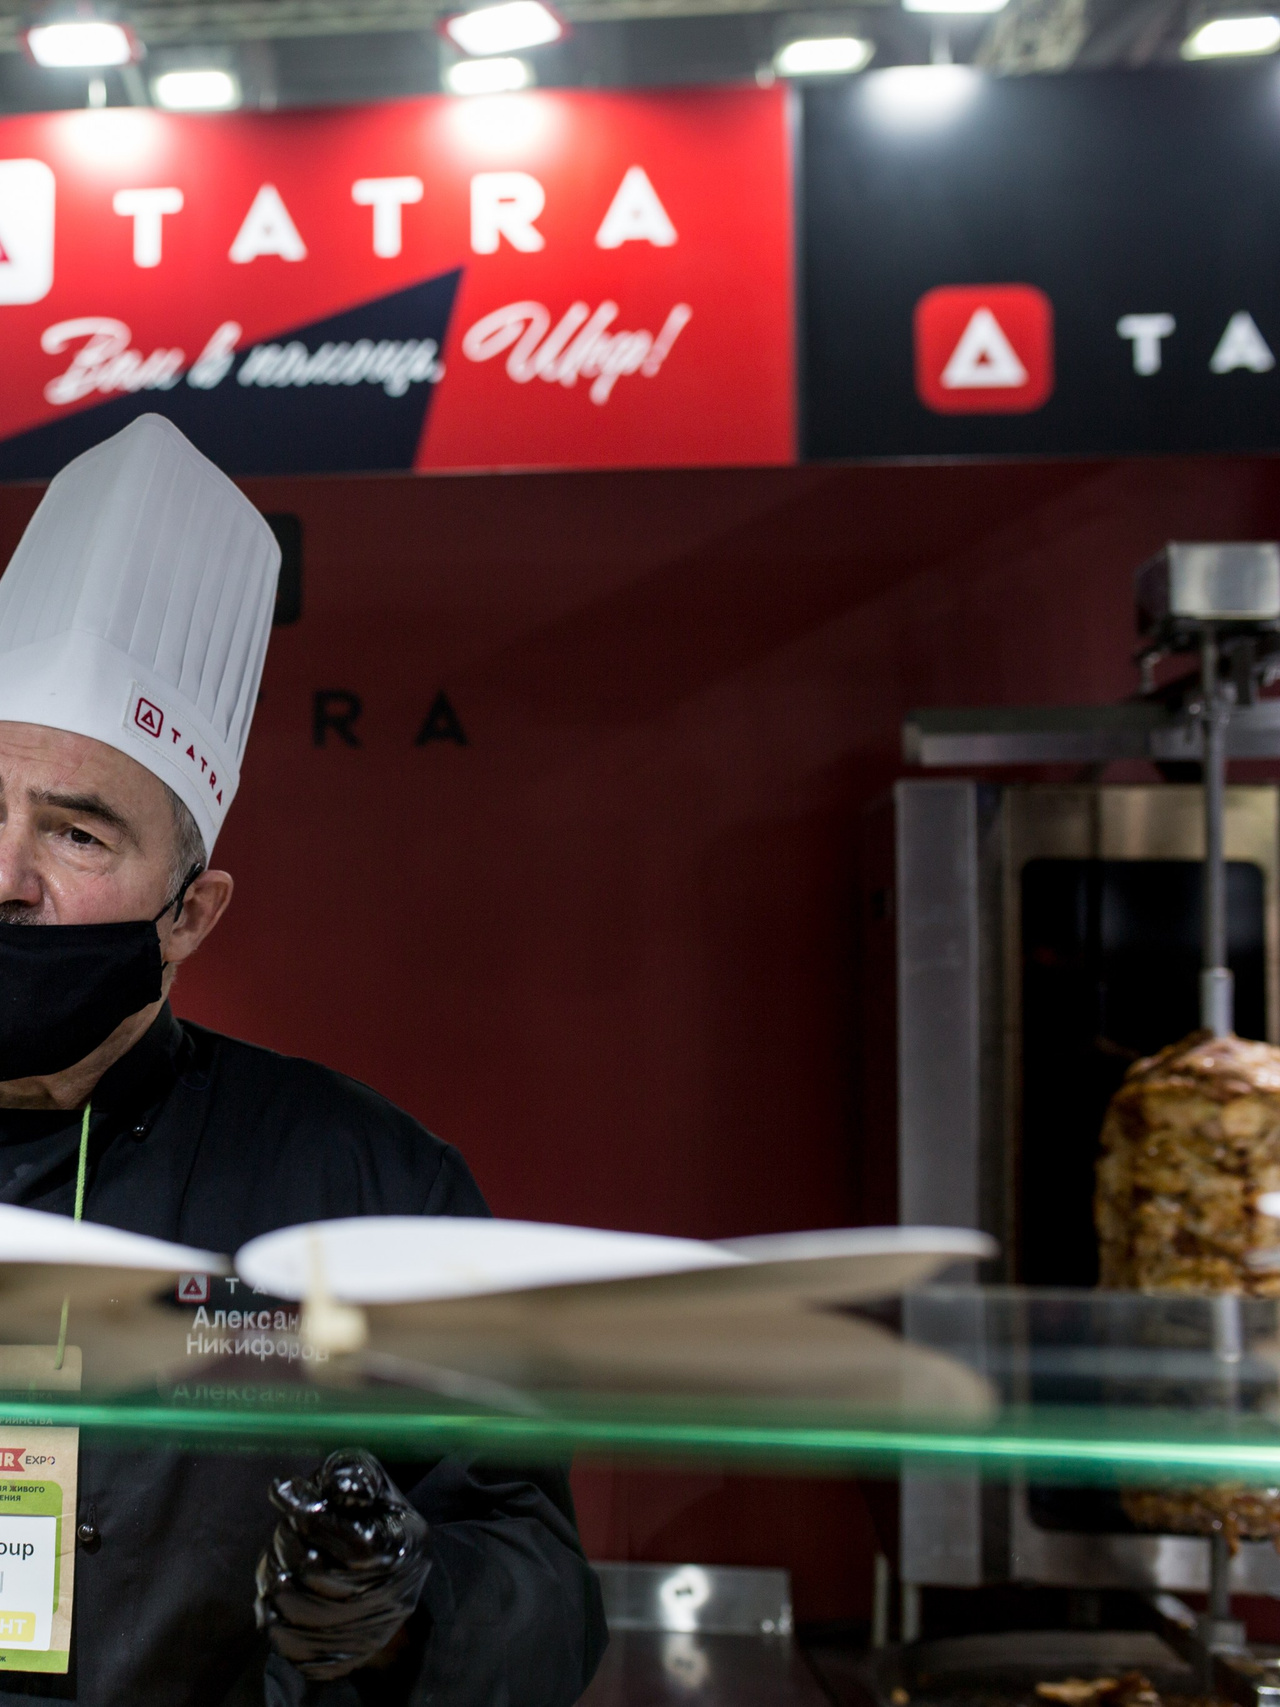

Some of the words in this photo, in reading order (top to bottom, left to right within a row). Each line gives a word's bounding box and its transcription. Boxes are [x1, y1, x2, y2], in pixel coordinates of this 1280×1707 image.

[112, 164, 679, 268] TATRA
[307, 688, 471, 750] RA
[171, 727, 223, 806] TATRA
[192, 1305, 301, 1330] Алексан
[9, 1485, 45, 1493] ЖИВОГО
